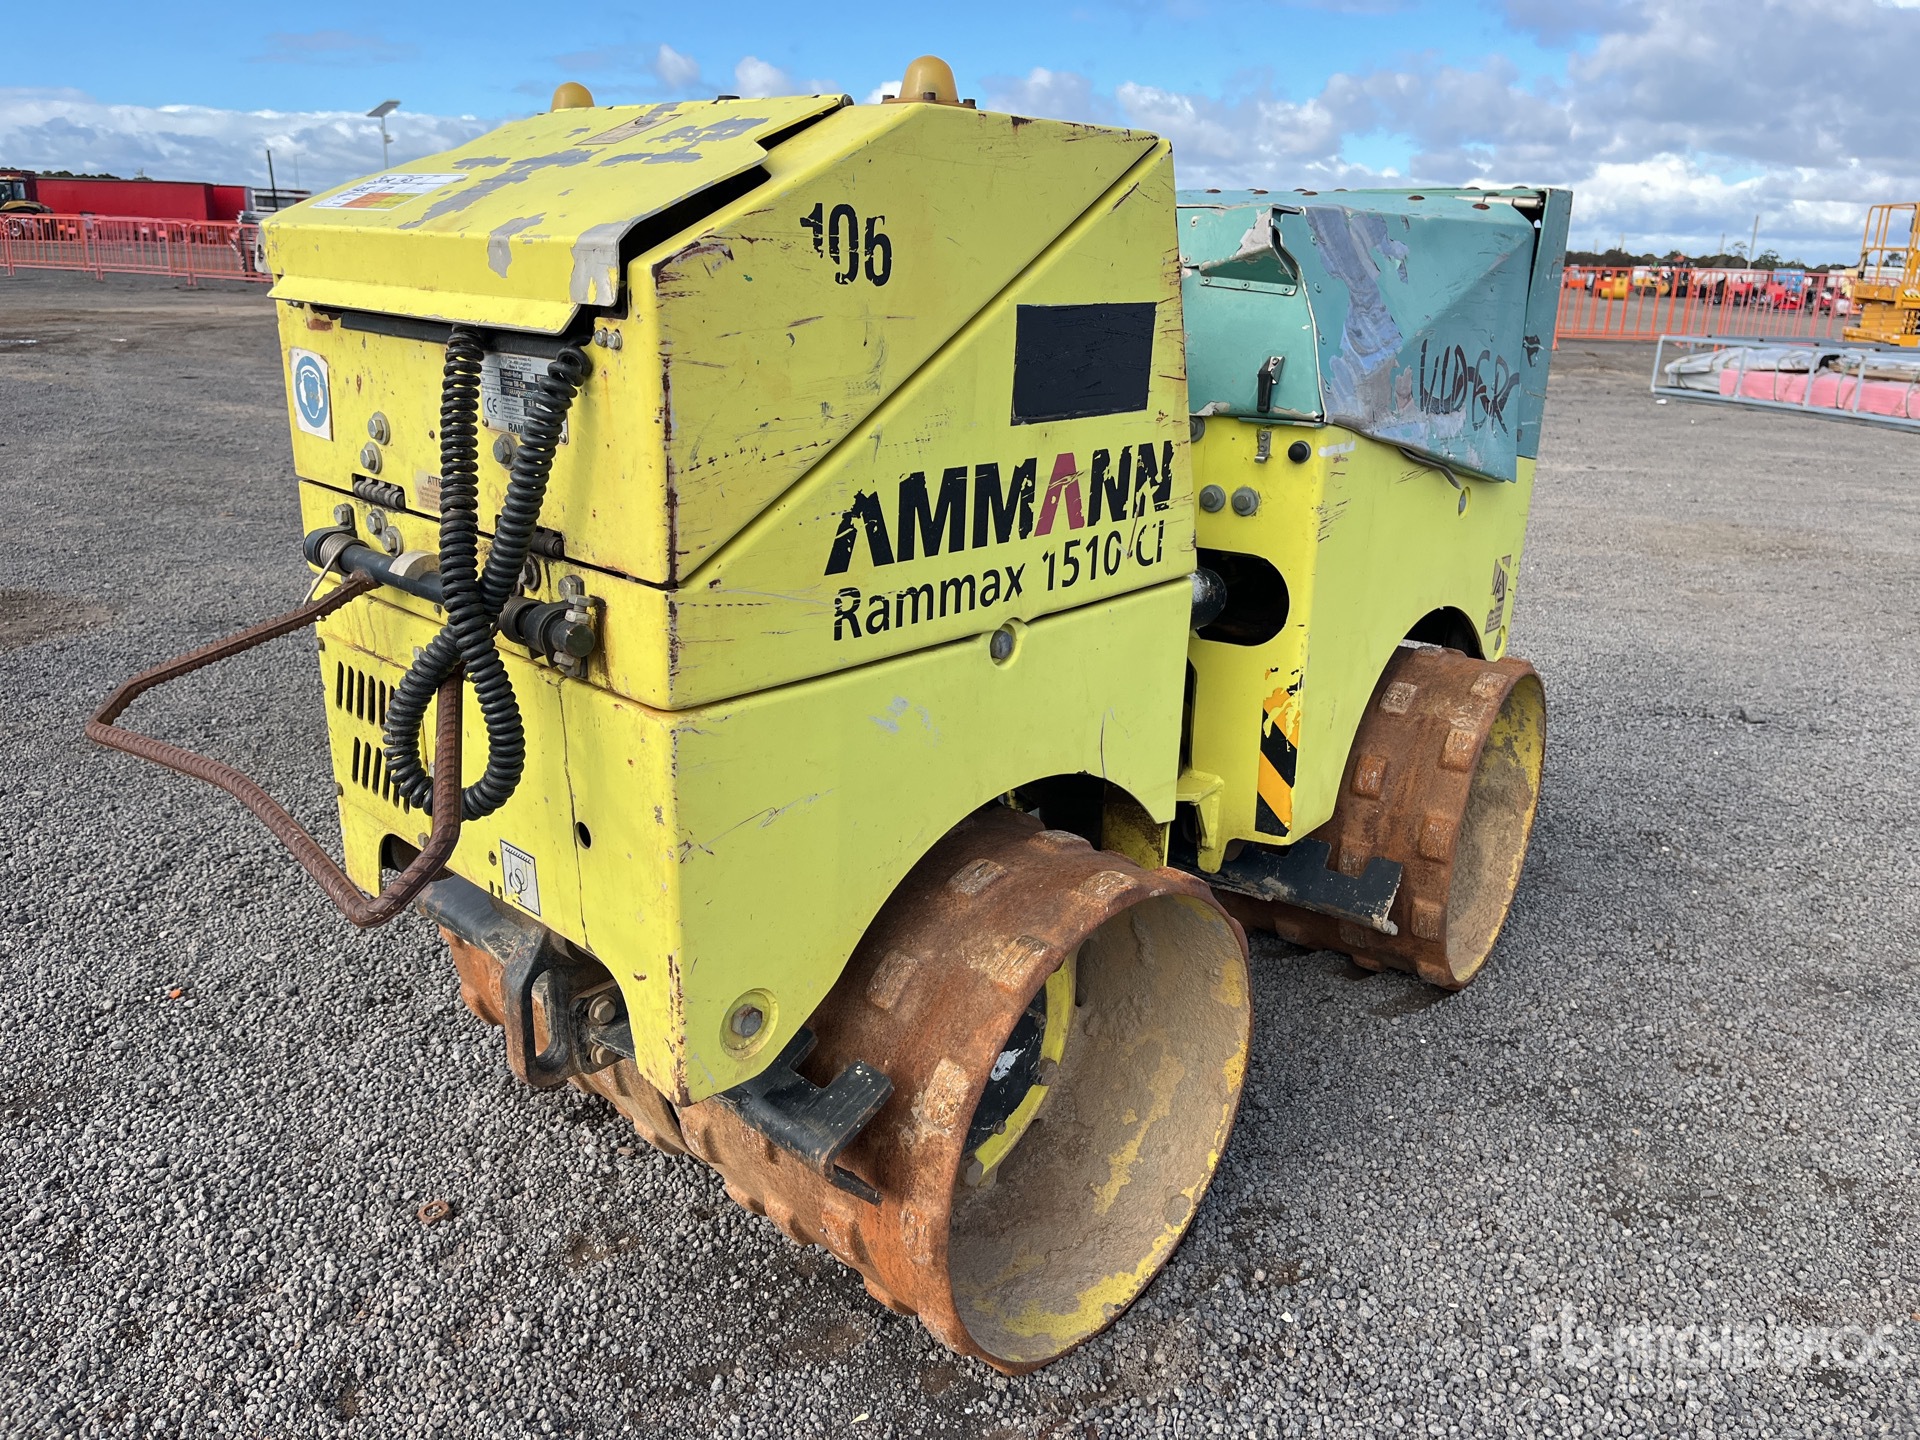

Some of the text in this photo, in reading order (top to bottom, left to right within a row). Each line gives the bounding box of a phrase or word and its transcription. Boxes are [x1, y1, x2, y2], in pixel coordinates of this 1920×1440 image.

[799, 202, 892, 286] 106
[824, 440, 1174, 576] AMMANN
[834, 563, 1026, 641] Rammax
